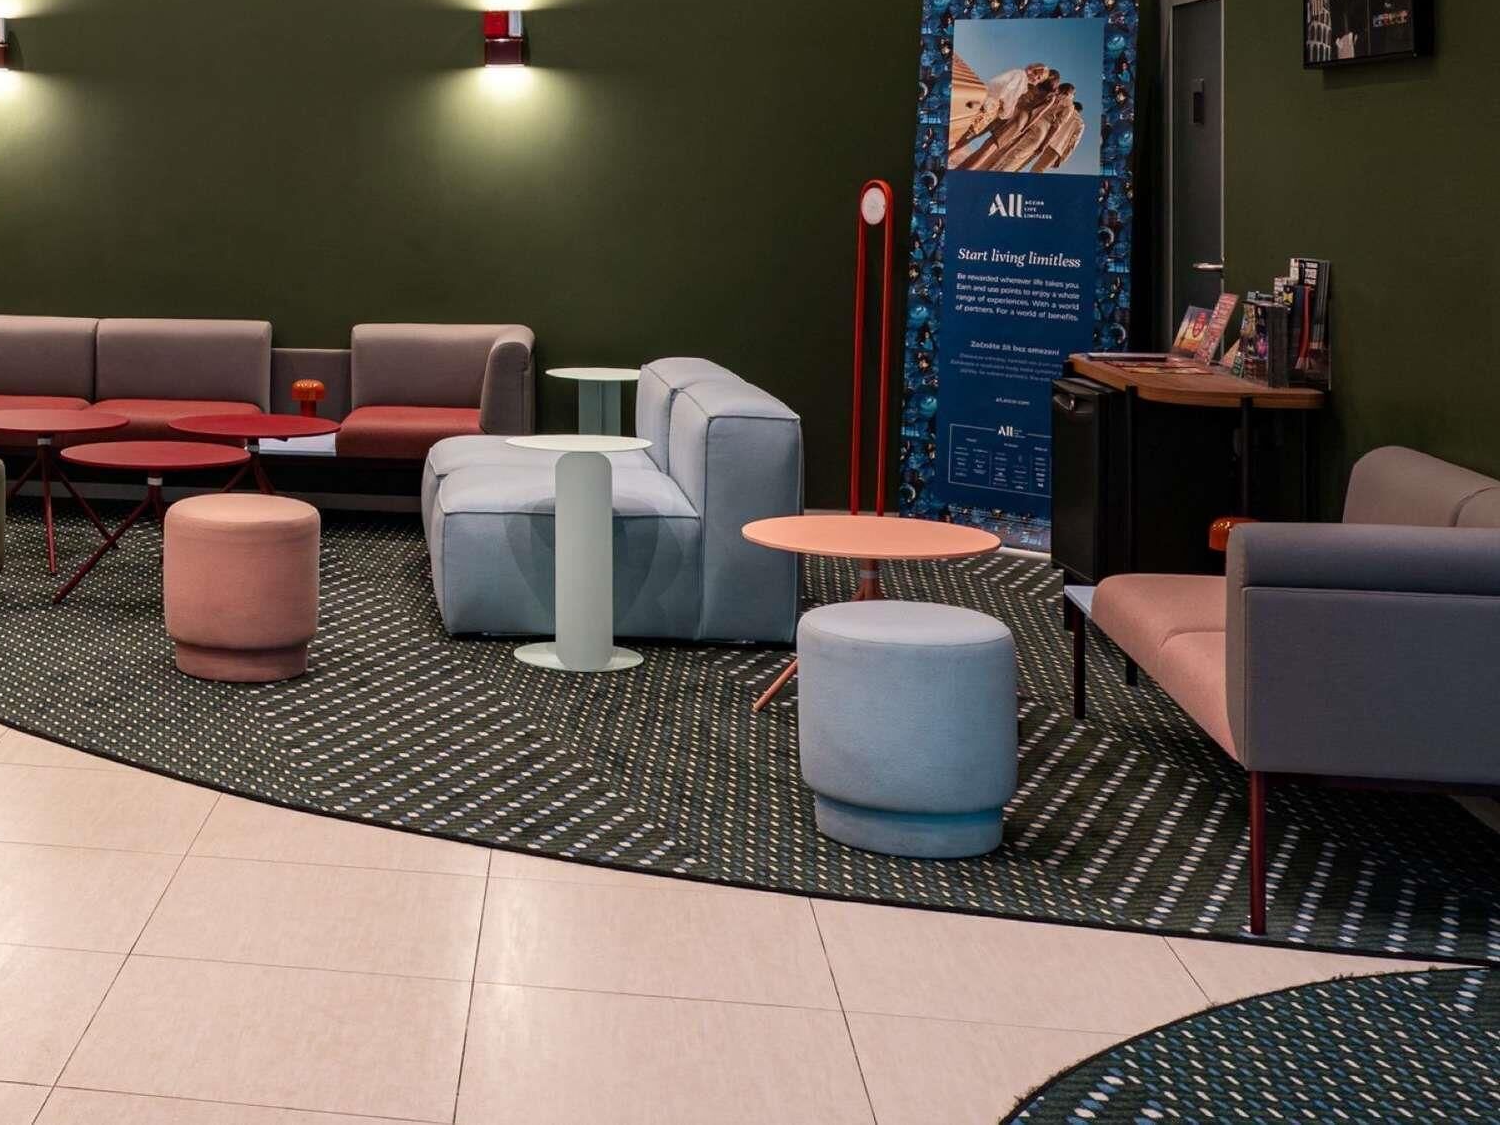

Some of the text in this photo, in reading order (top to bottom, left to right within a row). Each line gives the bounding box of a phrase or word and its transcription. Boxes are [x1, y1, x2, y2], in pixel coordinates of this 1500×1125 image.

[988, 193, 1022, 218] All
[957, 247, 1081, 268] Start living limitless
[967, 274, 999, 282] rewarded
[999, 275, 1031, 284] wherever
[1032, 276, 1044, 286] life
[1044, 279, 1064, 287] takes
[956, 282, 972, 290] Earn
[1000, 286, 1022, 296] points
[1031, 289, 1050, 298] enjoy
[1057, 291, 1080, 299] whole
[955, 294, 976, 302] range
[977, 294, 986, 302] of
[986, 295, 1029, 306] experiences.
[1031, 298, 1050, 308] With
[1058, 302, 1080, 311] world
[955, 303, 963, 311] of
[964, 305, 994, 314] partners.
[996, 306, 1008, 314] For
[1015, 308, 1037, 317] world
[1037, 310, 1046, 318] of
[1047, 311, 1079, 321] benefits.
[1012, 343, 1026, 353] bez
[1027, 346, 1060, 355] omezení
[997, 425, 1014, 437] All
